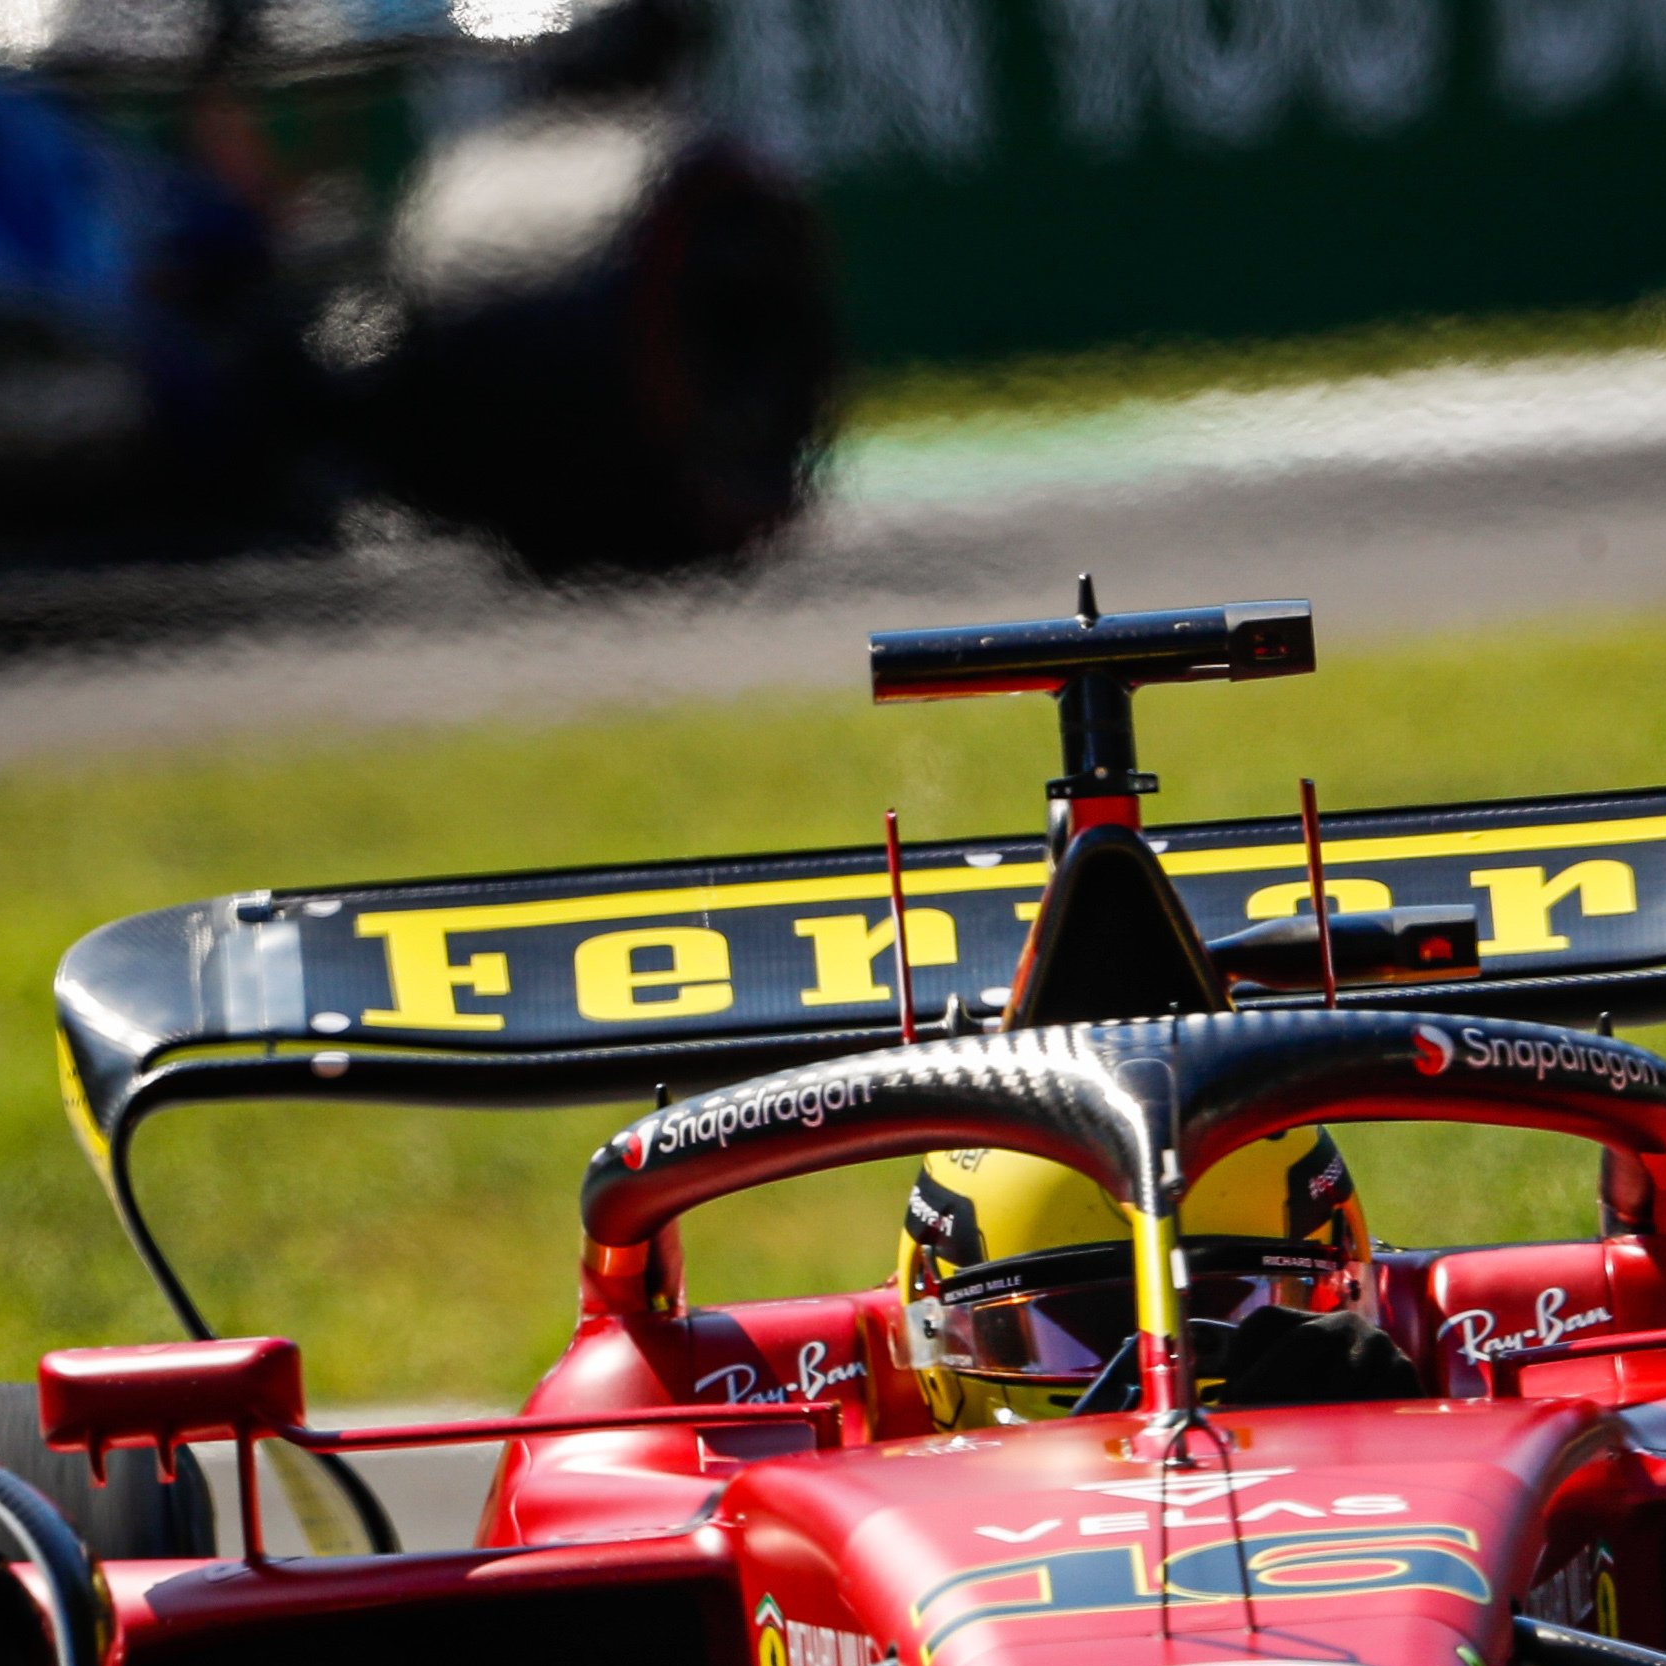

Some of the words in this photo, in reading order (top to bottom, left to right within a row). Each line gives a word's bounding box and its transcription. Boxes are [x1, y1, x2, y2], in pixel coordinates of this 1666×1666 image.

[1464, 1026, 1660, 1092] Snapdragon
[658, 1075, 873, 1155] Snapdragon
[1438, 1286, 1613, 1363] Ray-Ban
[974, 1494, 1409, 1543] VELAS
